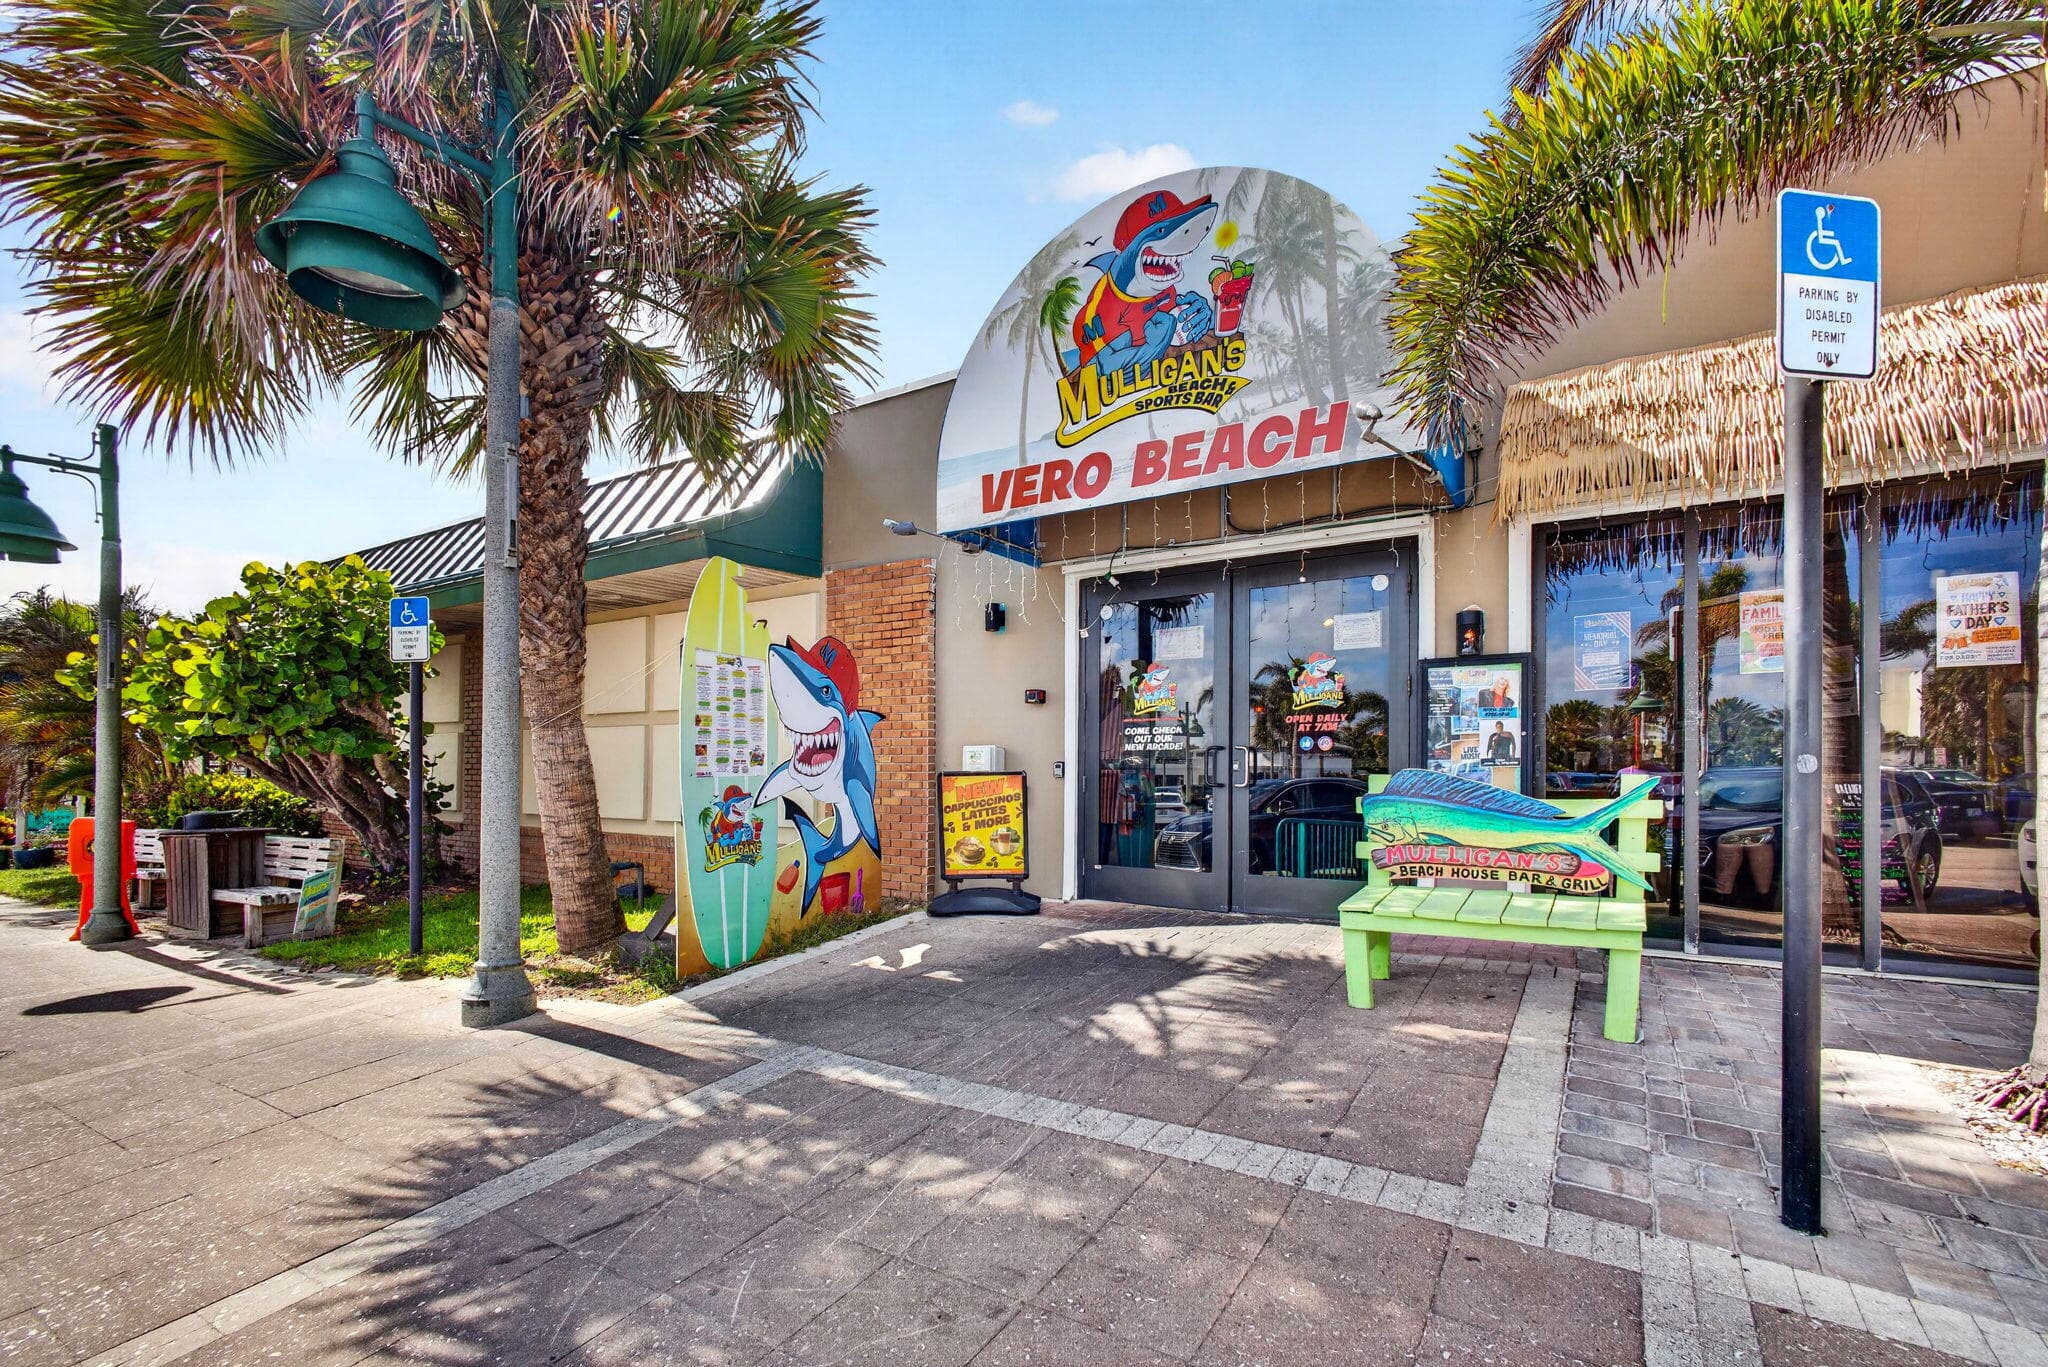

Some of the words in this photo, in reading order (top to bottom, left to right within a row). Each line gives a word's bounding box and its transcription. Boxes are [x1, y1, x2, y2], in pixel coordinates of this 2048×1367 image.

[1799, 287, 1840, 302] PARKING
[1846, 292, 1859, 303] BY
[1805, 308, 1853, 324] DISABLED
[1811, 330, 1847, 345] PERMIT
[1816, 351, 1840, 364] ONLY
[1057, 337, 1247, 425] MULLIGAN'S
[1168, 377, 1226, 394] BEACH
[1135, 392, 1194, 411] SPORTS
[1194, 391, 1224, 408] BAR
[980, 452, 1113, 514] VERO
[1131, 400, 1349, 488] BEACH
[1742, 606, 1783, 620] FAMIL
[1946, 601, 2010, 616] FATHER'S
[1965, 616, 1992, 629] DAY
[1285, 714, 1313, 723] OPEN
[1316, 713, 1348, 722] DAILY
[1124, 727, 1150, 735] COME
[1152, 726, 1183, 734] CHECK
[1298, 723, 1312, 731] AT
[1315, 722, 1338, 731] 7AM
[1134, 735, 1152, 743] OUT
[1154, 734, 1173, 742] OUR
[1146, 742, 1183, 750] ARCADE!
[956, 778, 1005, 802] NEW
[944, 792, 1021, 814] CAPPUCCINOS
[962, 805, 1007, 821] LATTES
[962, 822, 970, 831] &
[975, 815, 1010, 830] MORE
[1386, 845, 1562, 872] MULLIGAN'S
[1399, 865, 1444, 877] BEACH
[1450, 867, 1500, 880] HOUSE
[1508, 870, 1542, 884] BAR
[1544, 874, 1556, 886] &
[1558, 877, 1609, 892] GRILL
